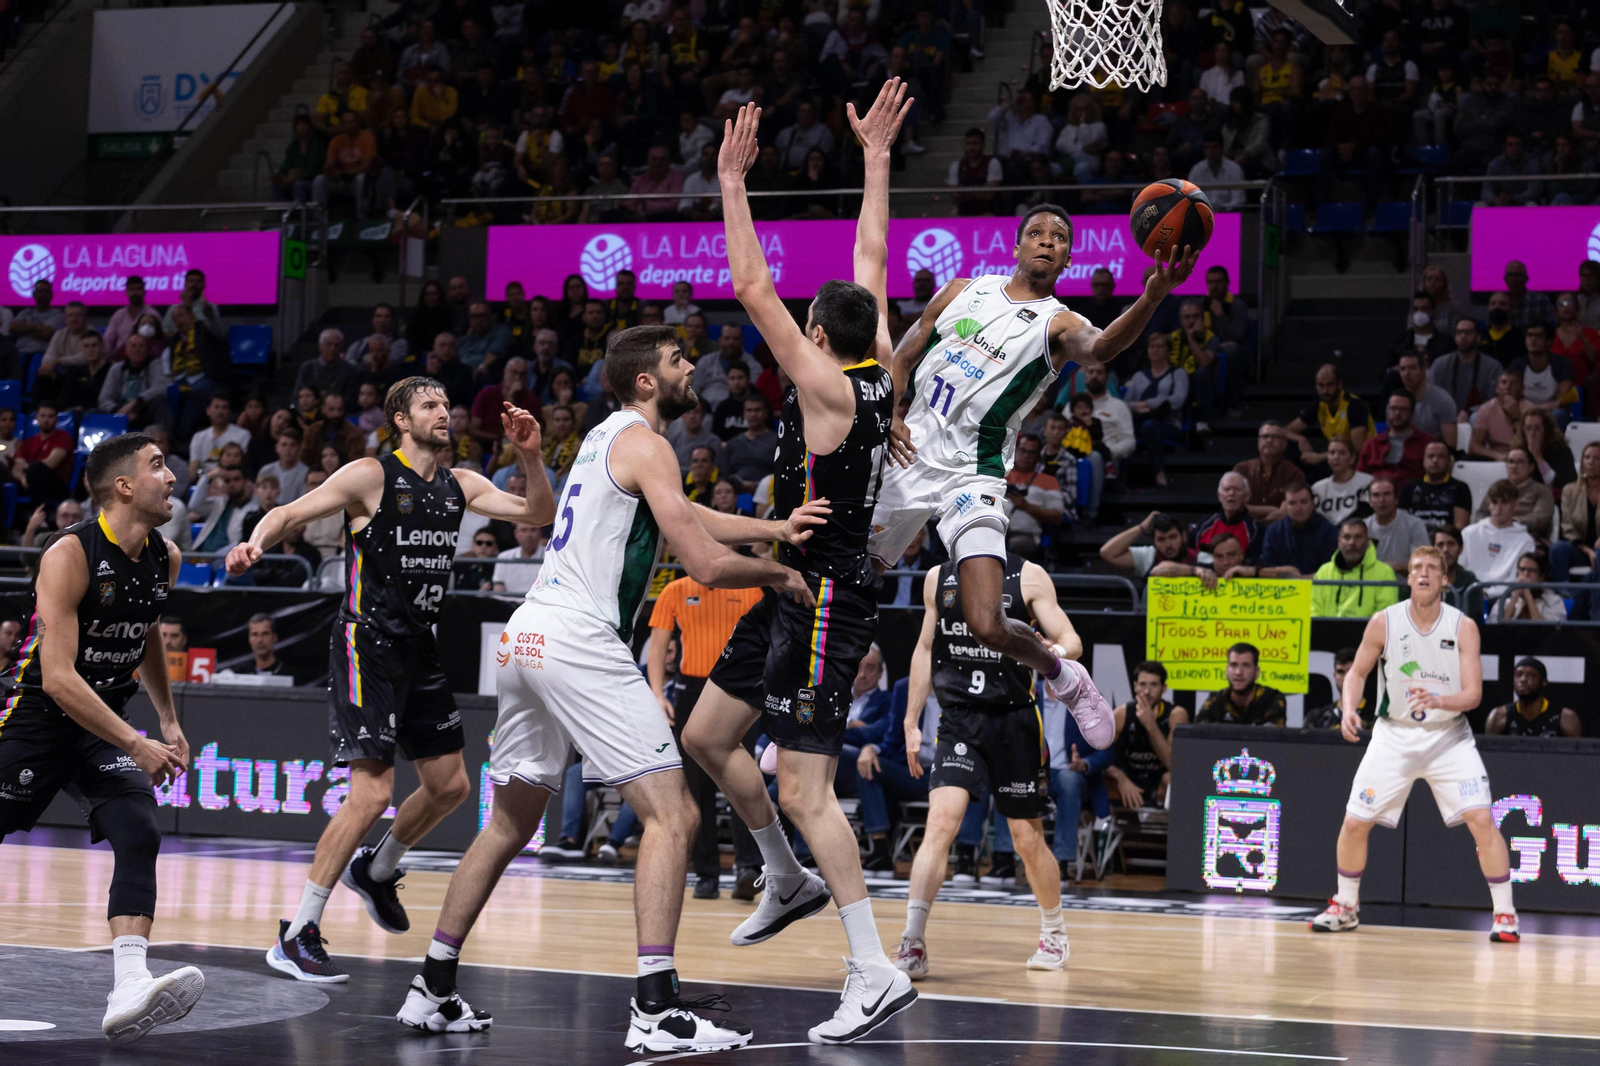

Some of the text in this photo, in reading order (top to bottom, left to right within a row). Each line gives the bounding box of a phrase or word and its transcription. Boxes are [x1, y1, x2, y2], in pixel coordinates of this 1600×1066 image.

[641, 233, 785, 259] LA LAGA
[973, 229, 1007, 255] LA
[63, 244, 188, 268] LA LAGUNA
[639, 262, 714, 288] deporte
[1108, 257, 1126, 280] ti
[60, 271, 126, 296] deporte
[929, 374, 956, 418] 11
[545, 483, 583, 552] 5
[401, 554, 452, 570] tenerife
[413, 583, 444, 613] 42
[1180, 599, 1287, 621] liga endesa
[86, 619, 157, 640] Lenov
[516, 632, 546, 647] COSTA
[514, 645, 544, 659] DEL SOL
[1172, 648, 1199, 661] UNO
[1202, 647, 1229, 660] PAR
[1262, 647, 1289, 660] DOS
[191, 657, 210, 684] 5
[968, 669, 985, 695] 9
[1170, 667, 1211, 680] LENOVO
[1420, 671, 1450, 683] Unicaja
[1011, 781, 1027, 789] Islas
